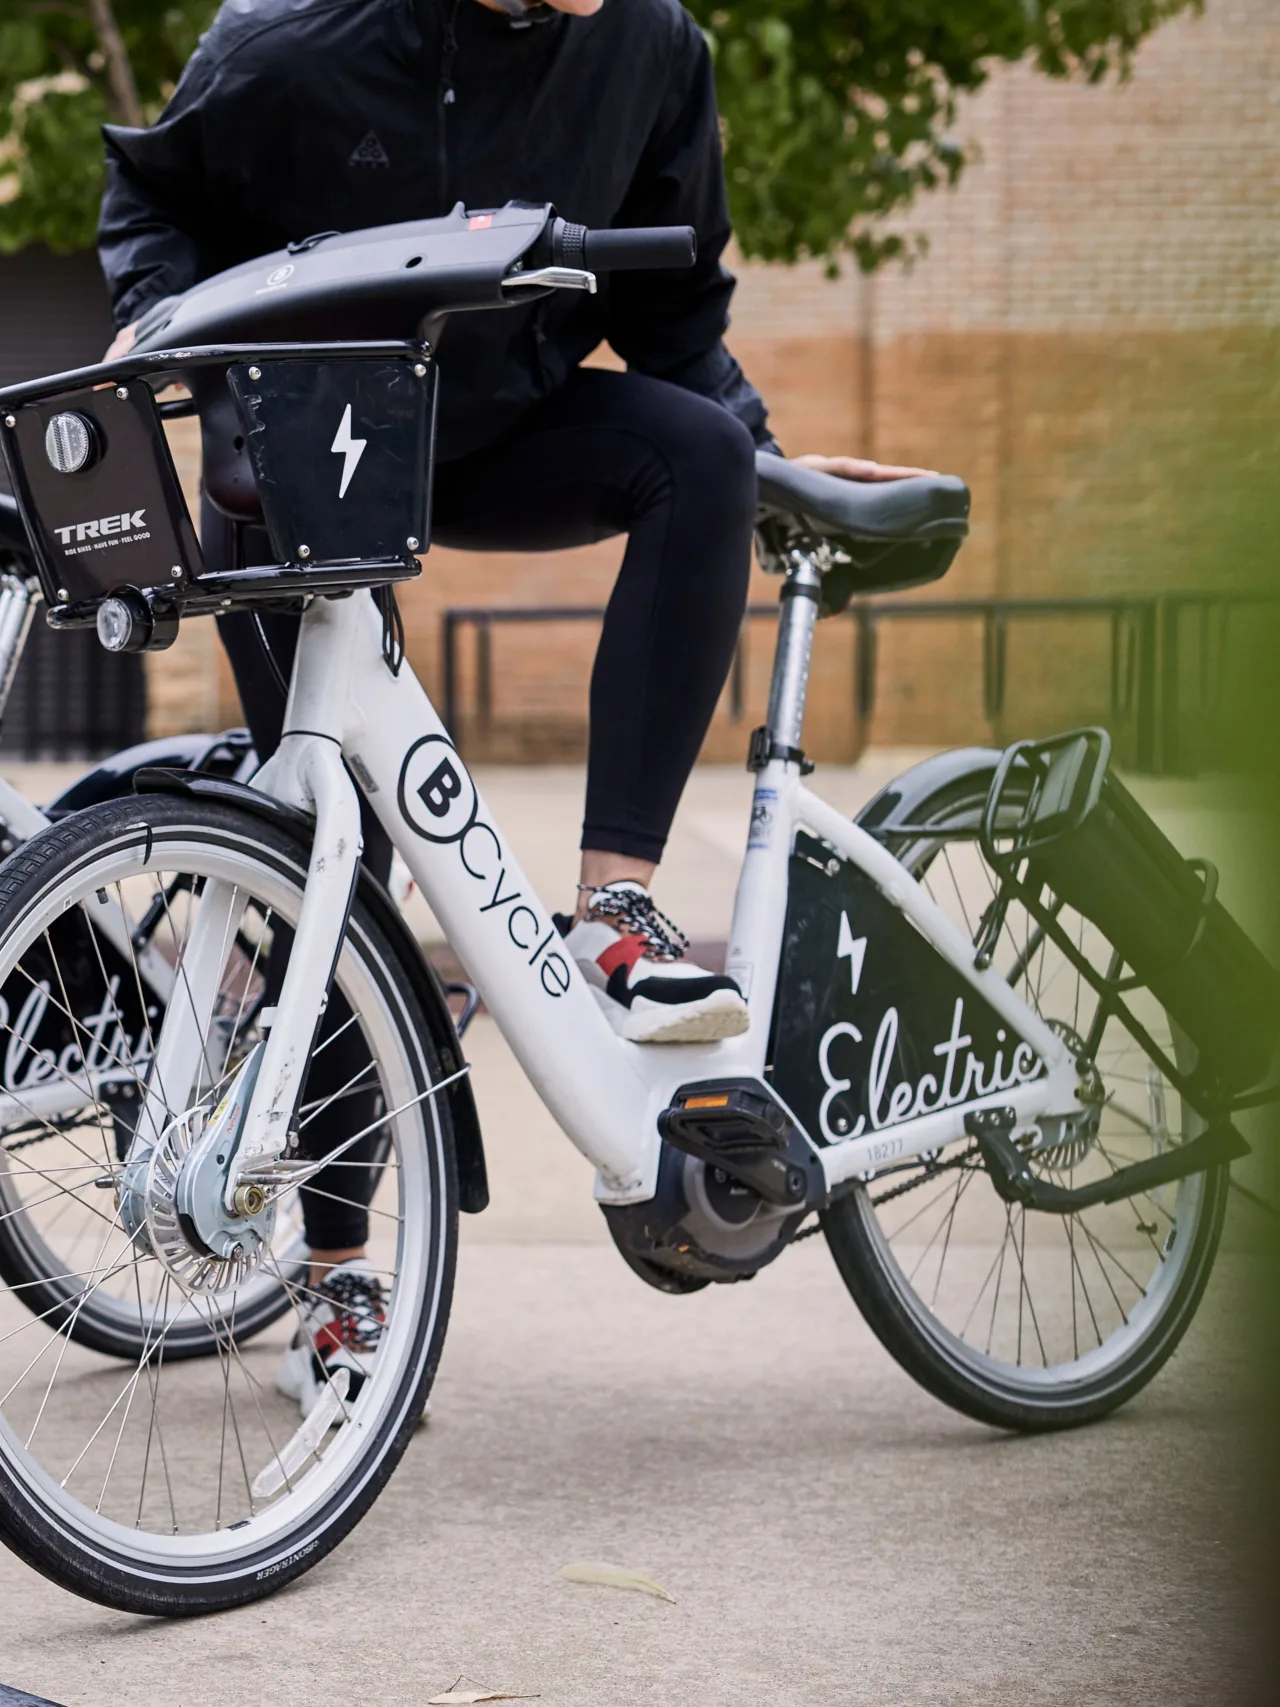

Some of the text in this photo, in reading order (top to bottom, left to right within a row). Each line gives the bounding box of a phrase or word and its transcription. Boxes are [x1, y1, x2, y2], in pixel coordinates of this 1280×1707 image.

[53, 508, 147, 545] TREK
[64, 532, 151, 556] RIDE BIKES HAVE FUN FEEL GOOD
[397, 734, 571, 998] BCycle
[818, 997, 1043, 1145] Electric
